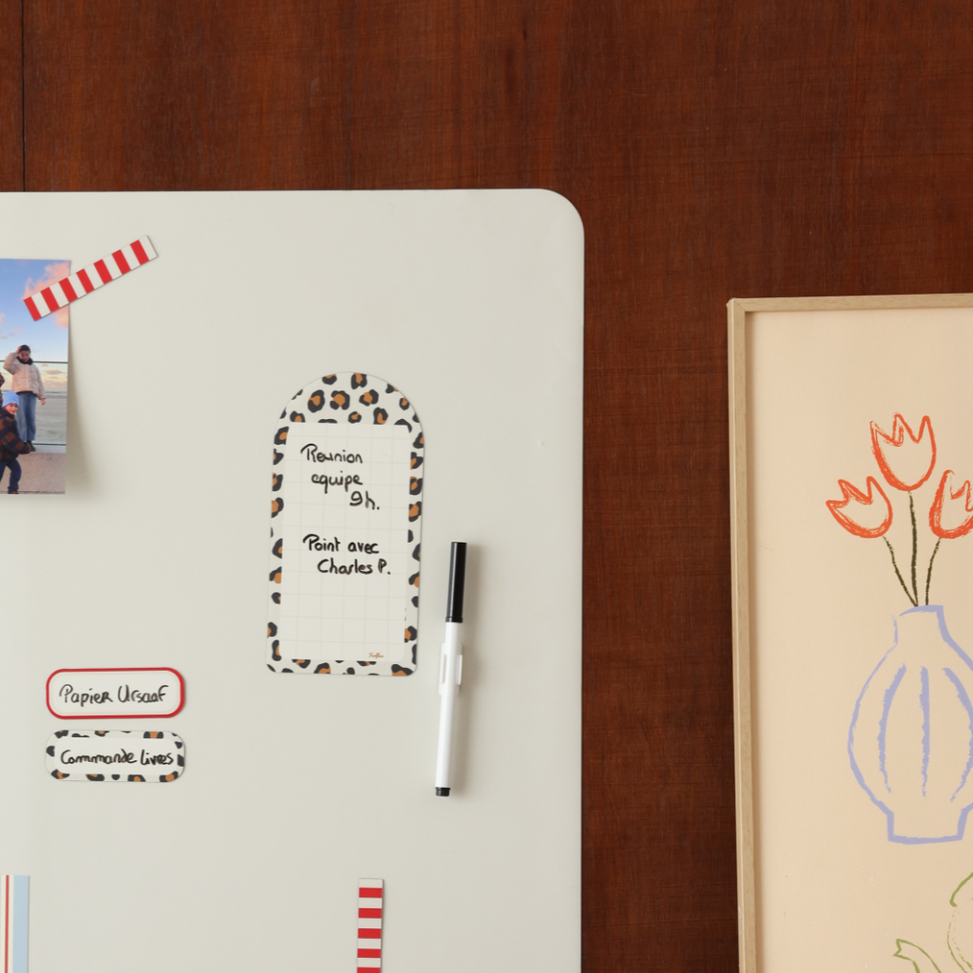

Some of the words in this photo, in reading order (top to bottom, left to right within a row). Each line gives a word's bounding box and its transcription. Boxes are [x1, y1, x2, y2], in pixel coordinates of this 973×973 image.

[311, 470, 363, 494] equipe
[302, 533, 341, 551] Point
[347, 542, 379, 554] avec
[317, 557, 373, 575] Charles
[59, 684, 113, 707] Papier
[60, 749, 137, 765] Commande
